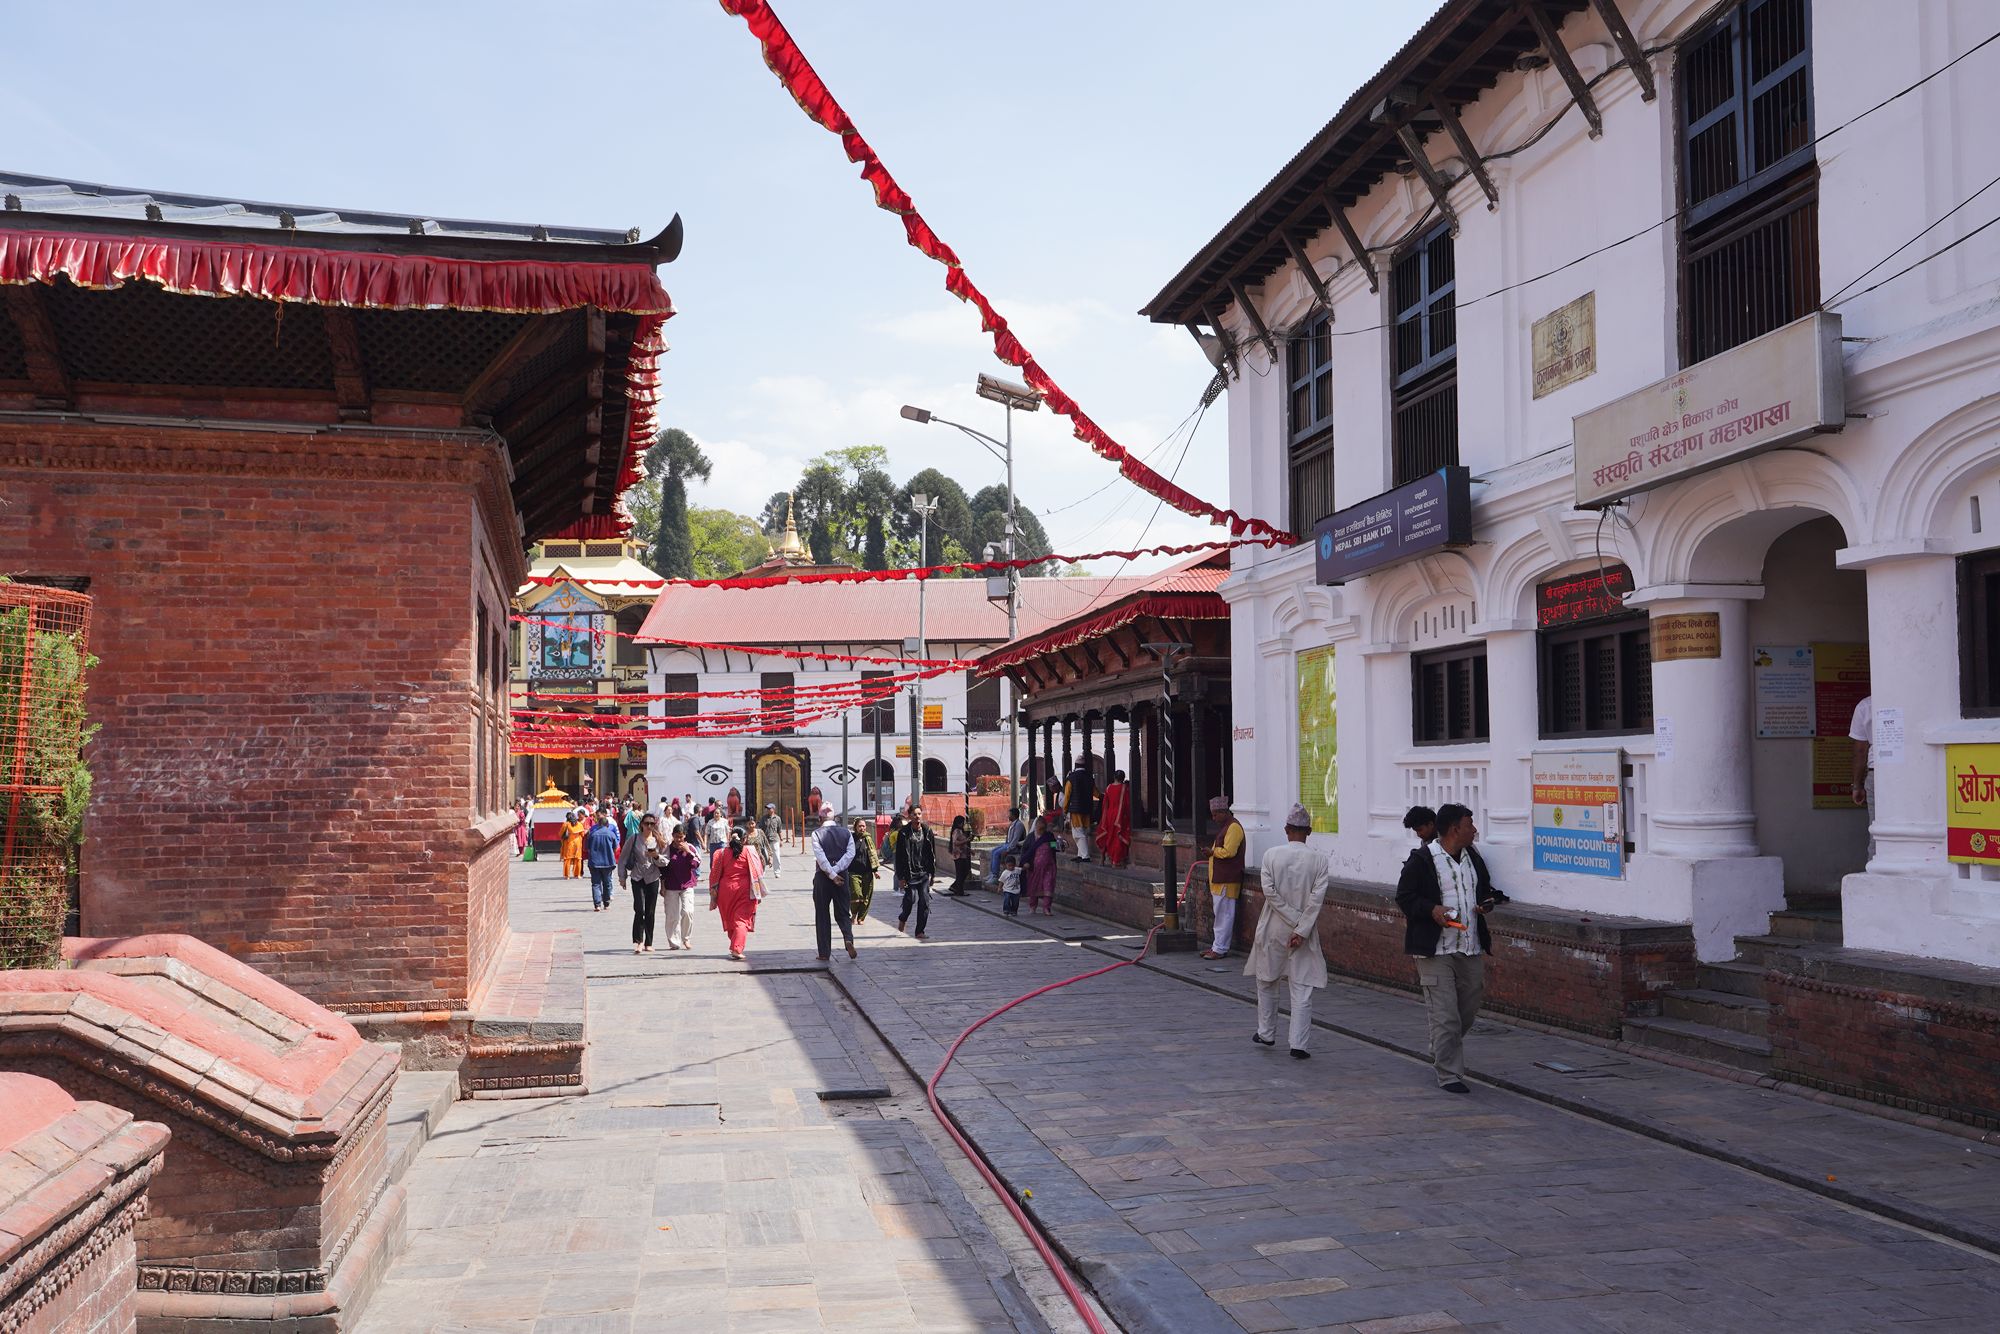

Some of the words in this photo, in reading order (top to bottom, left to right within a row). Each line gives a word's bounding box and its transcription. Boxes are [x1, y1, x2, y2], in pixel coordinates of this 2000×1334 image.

[1630, 426, 1660, 448] पशुपति
[1662, 421, 1679, 438] क्षेत्र
[1682, 409, 1714, 431] विकास
[1717, 398, 1739, 416] कोष
[1592, 450, 1643, 487] संस्कृति
[1648, 432, 1704, 468] संरक्षण
[1709, 400, 1791, 446] महाशाखा
[1404, 530, 1424, 542] EXTENSION
[1424, 523, 1442, 536] COUNTER
[1412, 518, 1432, 530] PASHUPATI
[1334, 539, 1352, 553] NEPAL
[1353, 535, 1362, 547] SBI
[1363, 529, 1379, 543] BANK
[1380, 525, 1393, 537] LTD.
[1672, 633, 1695, 641] SPECIAL
[1696, 632, 1716, 640] POOJA
[1536, 834, 1577, 850] DONATION
[1577, 838, 1618, 853] COUNTER
[1543, 852, 1572, 866] (PURCHY
[1573, 856, 1611, 870] COUNTER)
